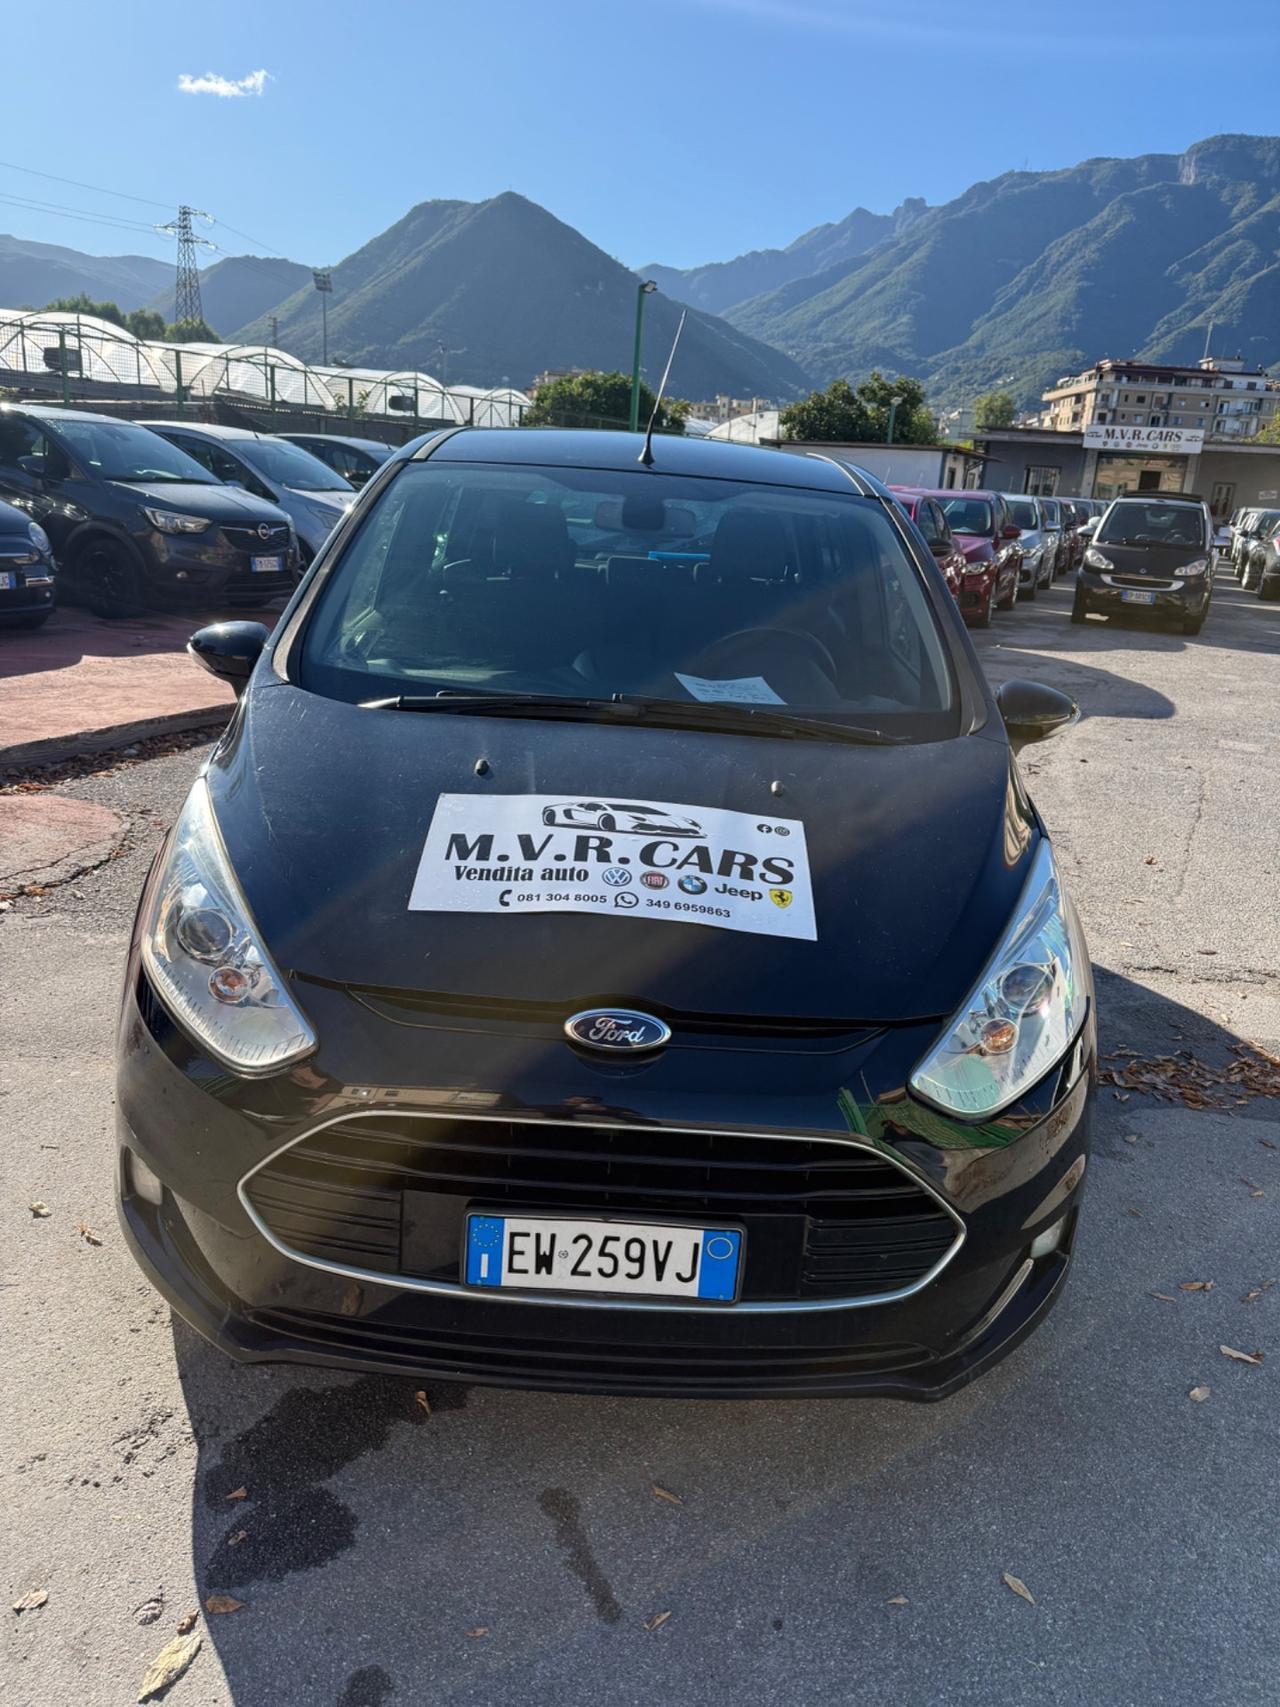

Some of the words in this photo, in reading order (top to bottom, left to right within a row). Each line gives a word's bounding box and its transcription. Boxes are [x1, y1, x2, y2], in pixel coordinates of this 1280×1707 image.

[1147, 430, 1183, 442] CARS
[639, 840, 794, 886] CARS
[454, 865, 533, 882] Vendita
[541, 866, 589, 882] auto
[517, 893, 541, 902] 081
[545, 893, 570, 902] 304
[714, 883, 763, 901] Jeep
[646, 899, 670, 908] 349
[674, 902, 731, 918] 6959863
[589, 1017, 645, 1043] Ford
